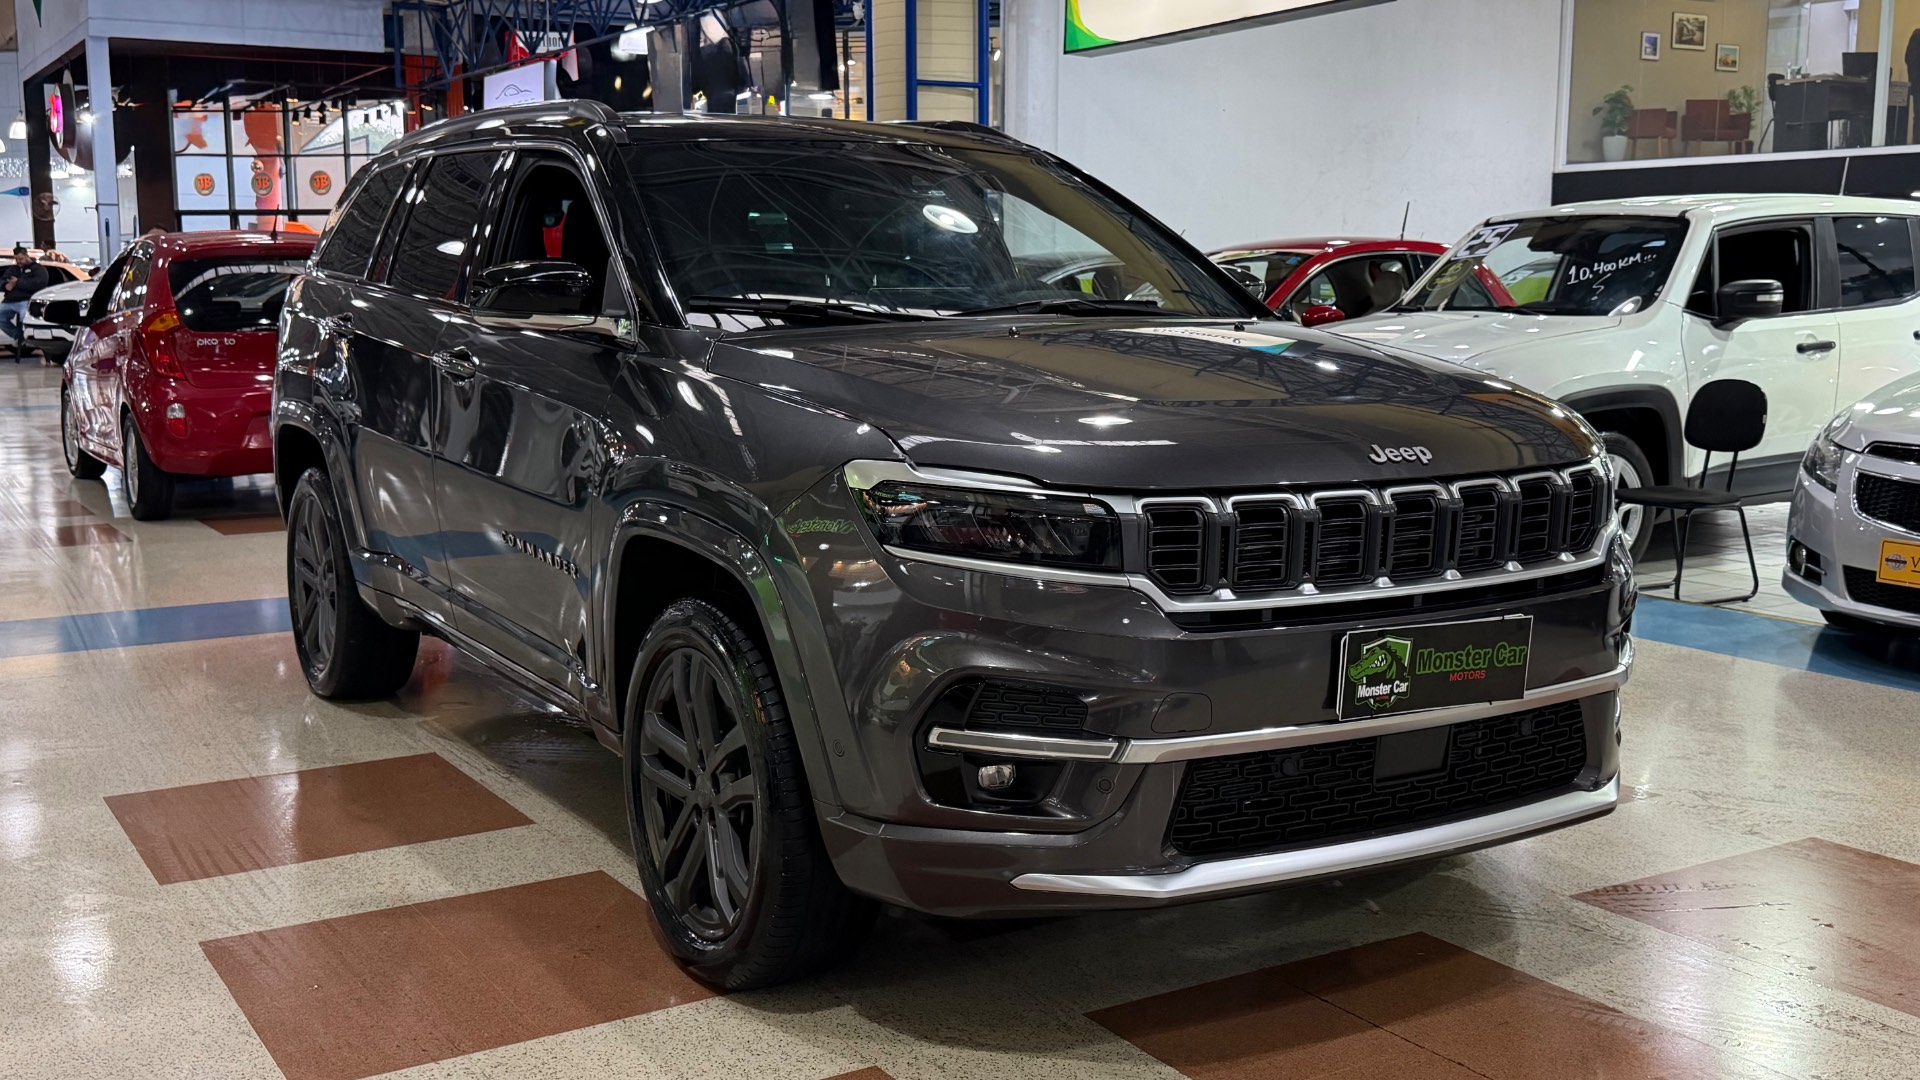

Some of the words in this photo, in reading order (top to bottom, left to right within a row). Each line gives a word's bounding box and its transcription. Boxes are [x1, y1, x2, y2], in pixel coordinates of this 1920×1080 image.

[1457, 227, 1511, 257] 25
[1368, 444, 1433, 465] Jeep
[501, 530, 578, 579] COMMANDER
[1416, 645, 1492, 674] Monster
[1494, 641, 1527, 667] Car
[1449, 670, 1487, 681] MOTORS
[1357, 682, 1392, 699] Monster
[1393, 680, 1409, 693] Car
